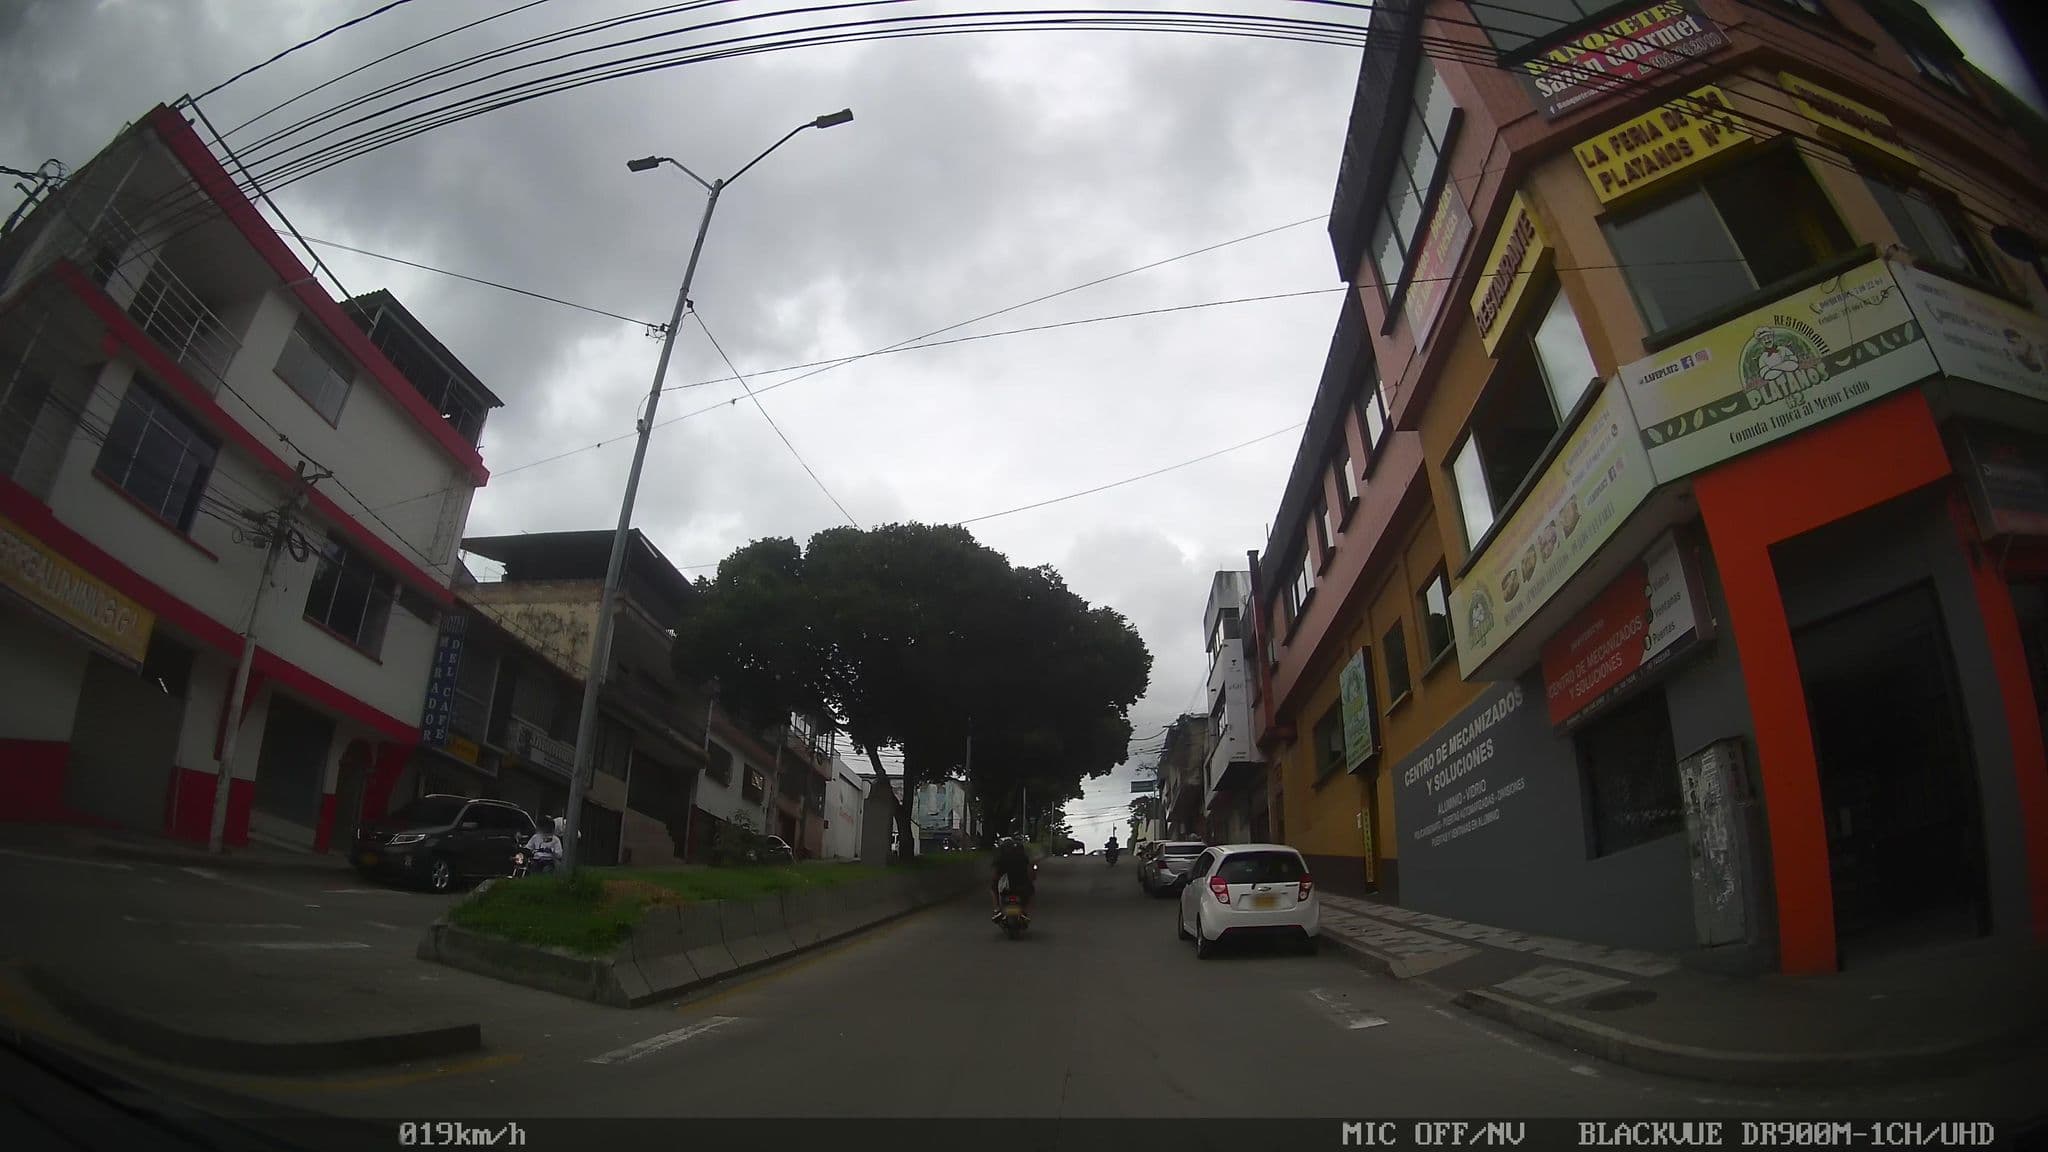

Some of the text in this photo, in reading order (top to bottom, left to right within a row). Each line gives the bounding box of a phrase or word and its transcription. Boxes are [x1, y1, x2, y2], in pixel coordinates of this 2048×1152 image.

[1605, 14, 1702, 67] Gourmet
[1579, 107, 1689, 169] LA FERIA DE
[1597, 137, 1694, 193] PLATANOS
[1475, 208, 1536, 339] RESTAURANTE
[1774, 314, 1830, 355] RESTAURANTE
[1730, 421, 1769, 445] Comida
[1803, 401, 1814, 416] al
[1814, 392, 1842, 411] Mejor
[1843, 380, 1870, 400] Estilo
[1745, 361, 1831, 411] PLATANOS
[446, 639, 461, 677] DEL
[1548, 667, 1576, 699] CENTRO
[1575, 660, 1587, 678] DE
[1586, 615, 1643, 667] MECANIZADOS
[1575, 652, 1624, 697] SOLUCIONES
[423, 636, 449, 741] MIRADOR
[1404, 753, 1435, 787] CENTRO
[1435, 742, 1449, 766] DE
[1448, 685, 1523, 756] MECANIZADOS
[1426, 738, 1494, 796] Y SOLUCIONES
